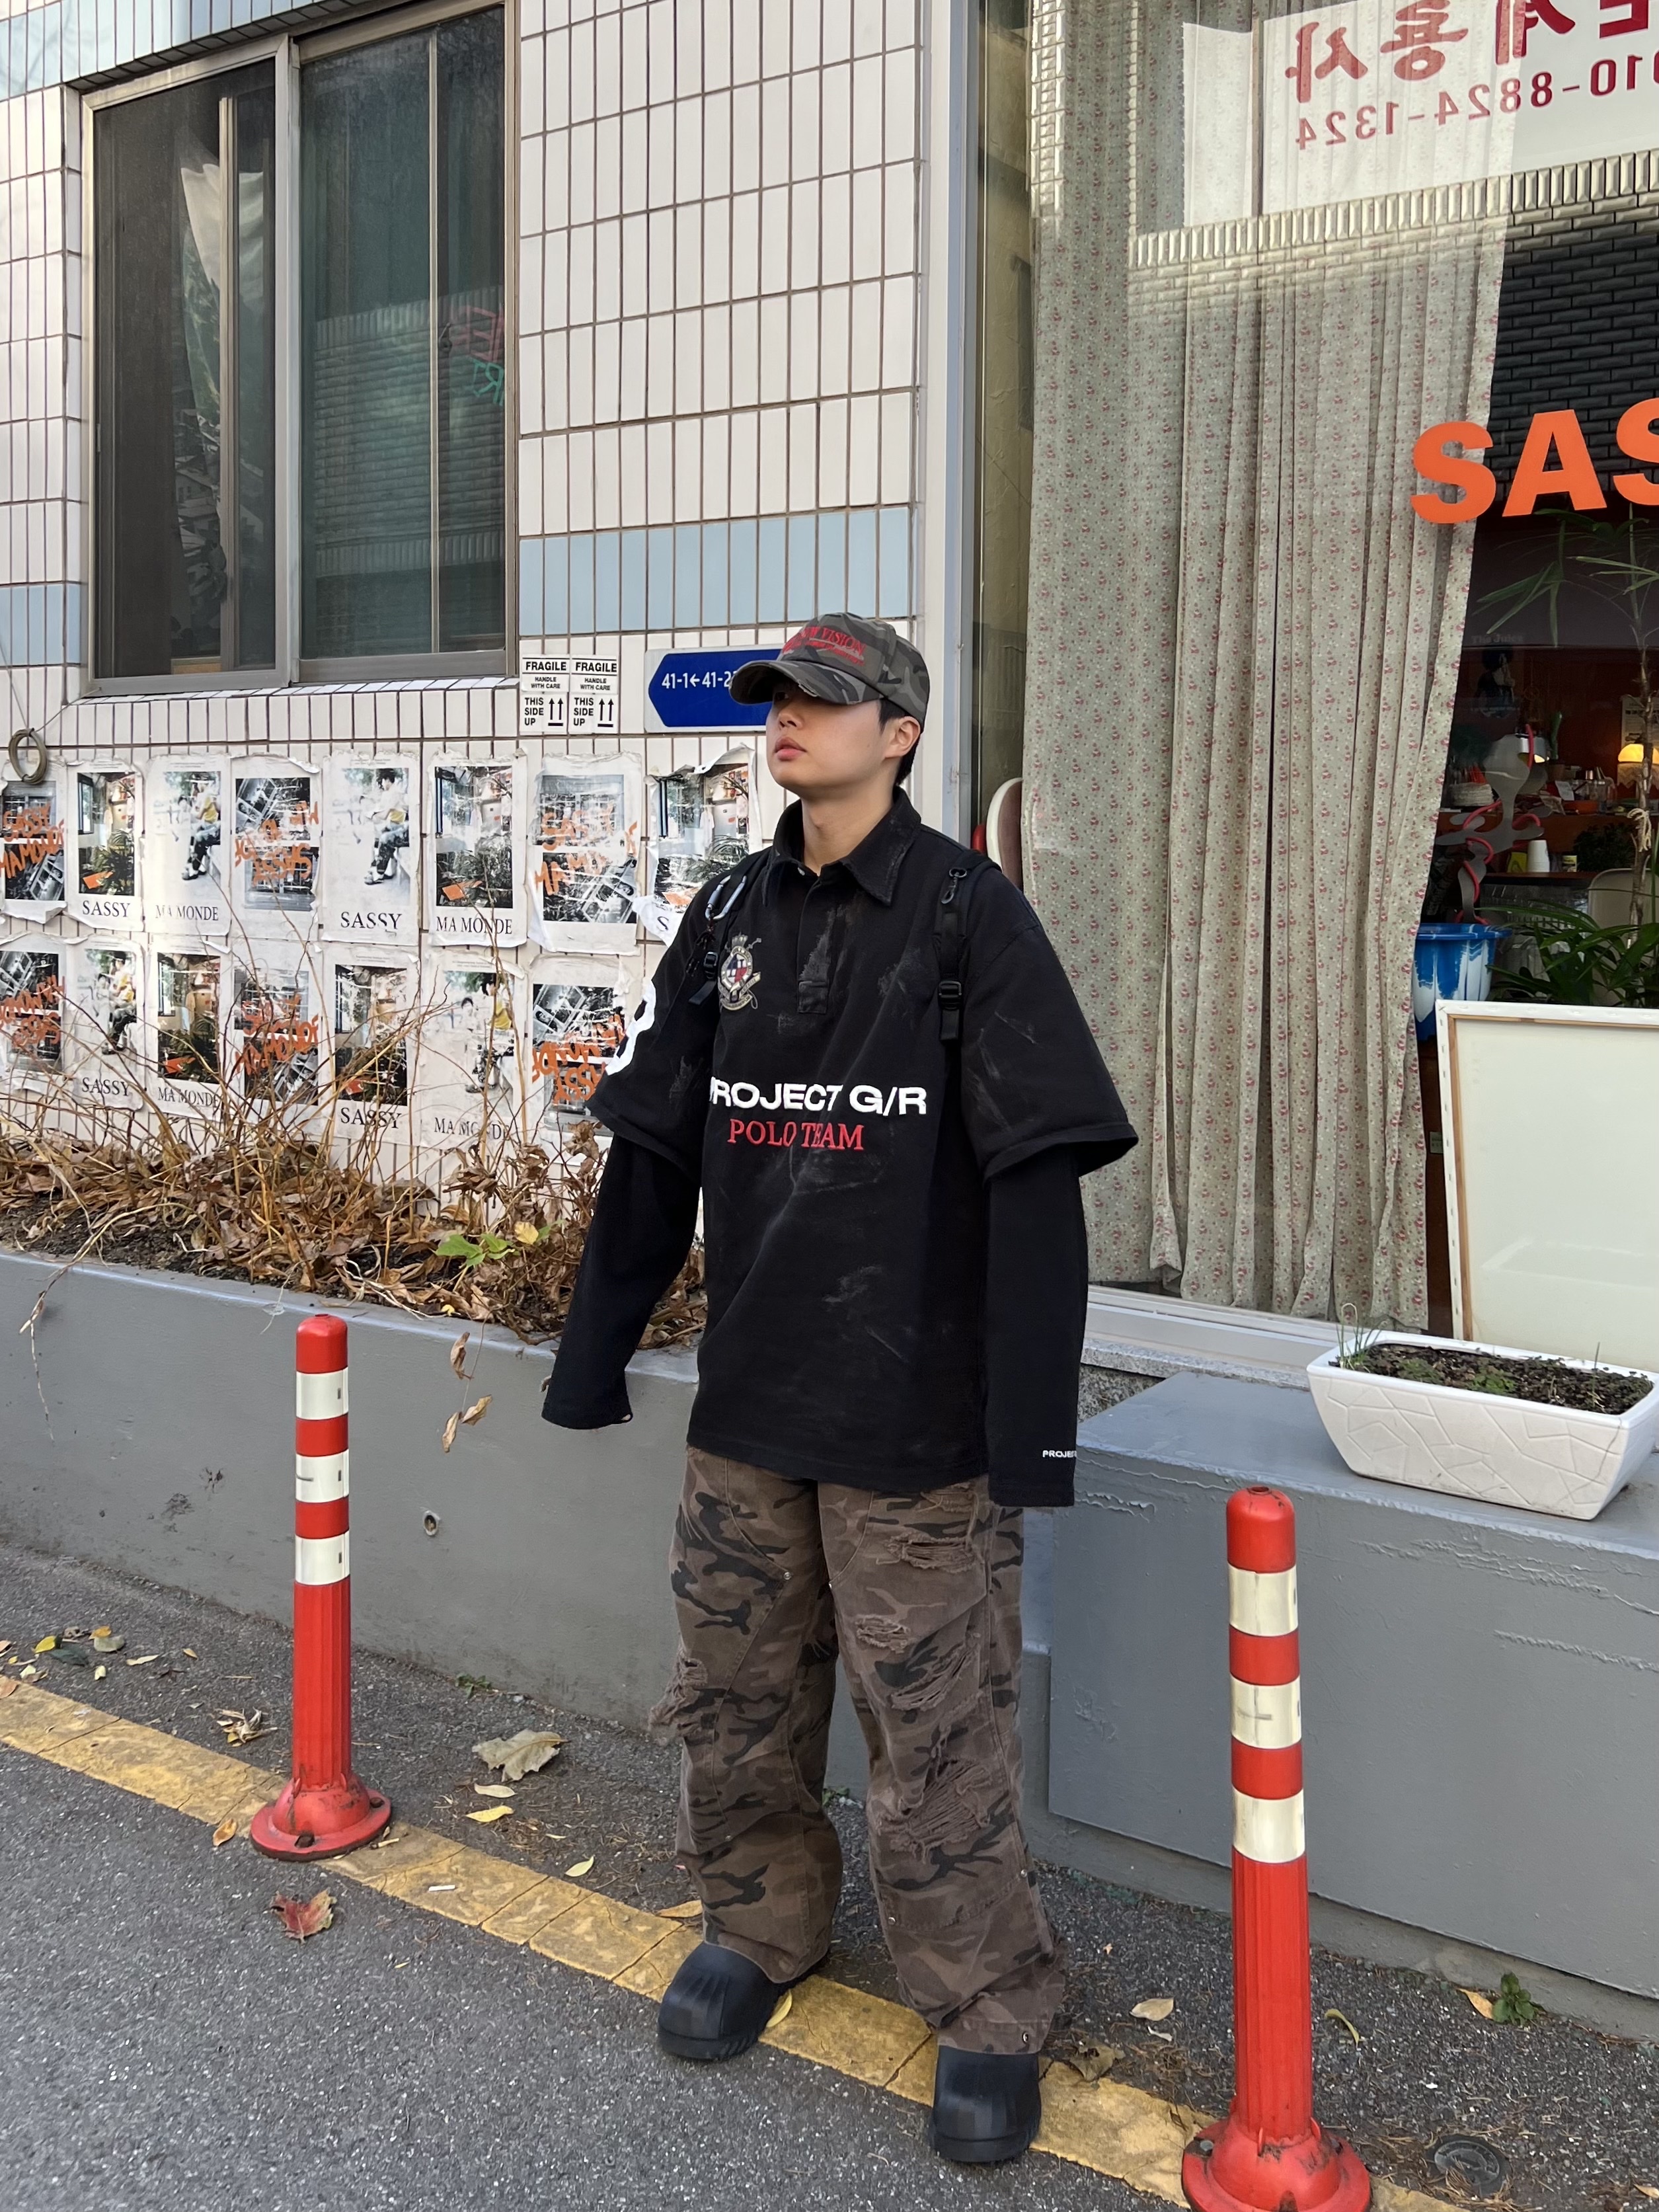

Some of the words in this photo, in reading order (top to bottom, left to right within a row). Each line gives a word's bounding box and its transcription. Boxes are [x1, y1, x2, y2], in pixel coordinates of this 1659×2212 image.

[525, 661, 566, 671] FRAGILE
[575, 662, 617, 673] FRAGILE
[662, 673, 688, 689] 41-1
[574, 697, 594, 706] THIS
[525, 707, 544, 716] SIDE
[573, 718, 586, 727] UP
[83, 900, 130, 918] SASSY
[176, 905, 219, 921] MONDE
[340, 911, 402, 929] SASSY
[436, 916, 456, 932] MA
[461, 917, 512, 934] MONDE
[81, 1077, 130, 1096] SASSY
[157, 1087, 176, 1102] MA
[849, 1085, 927, 1116] G/R
[340, 1107, 402, 1129] SASSY
[434, 1117, 455, 1134] MA
[728, 1118, 797, 1147] POLO
[801, 1122, 865, 1151] TEAM
